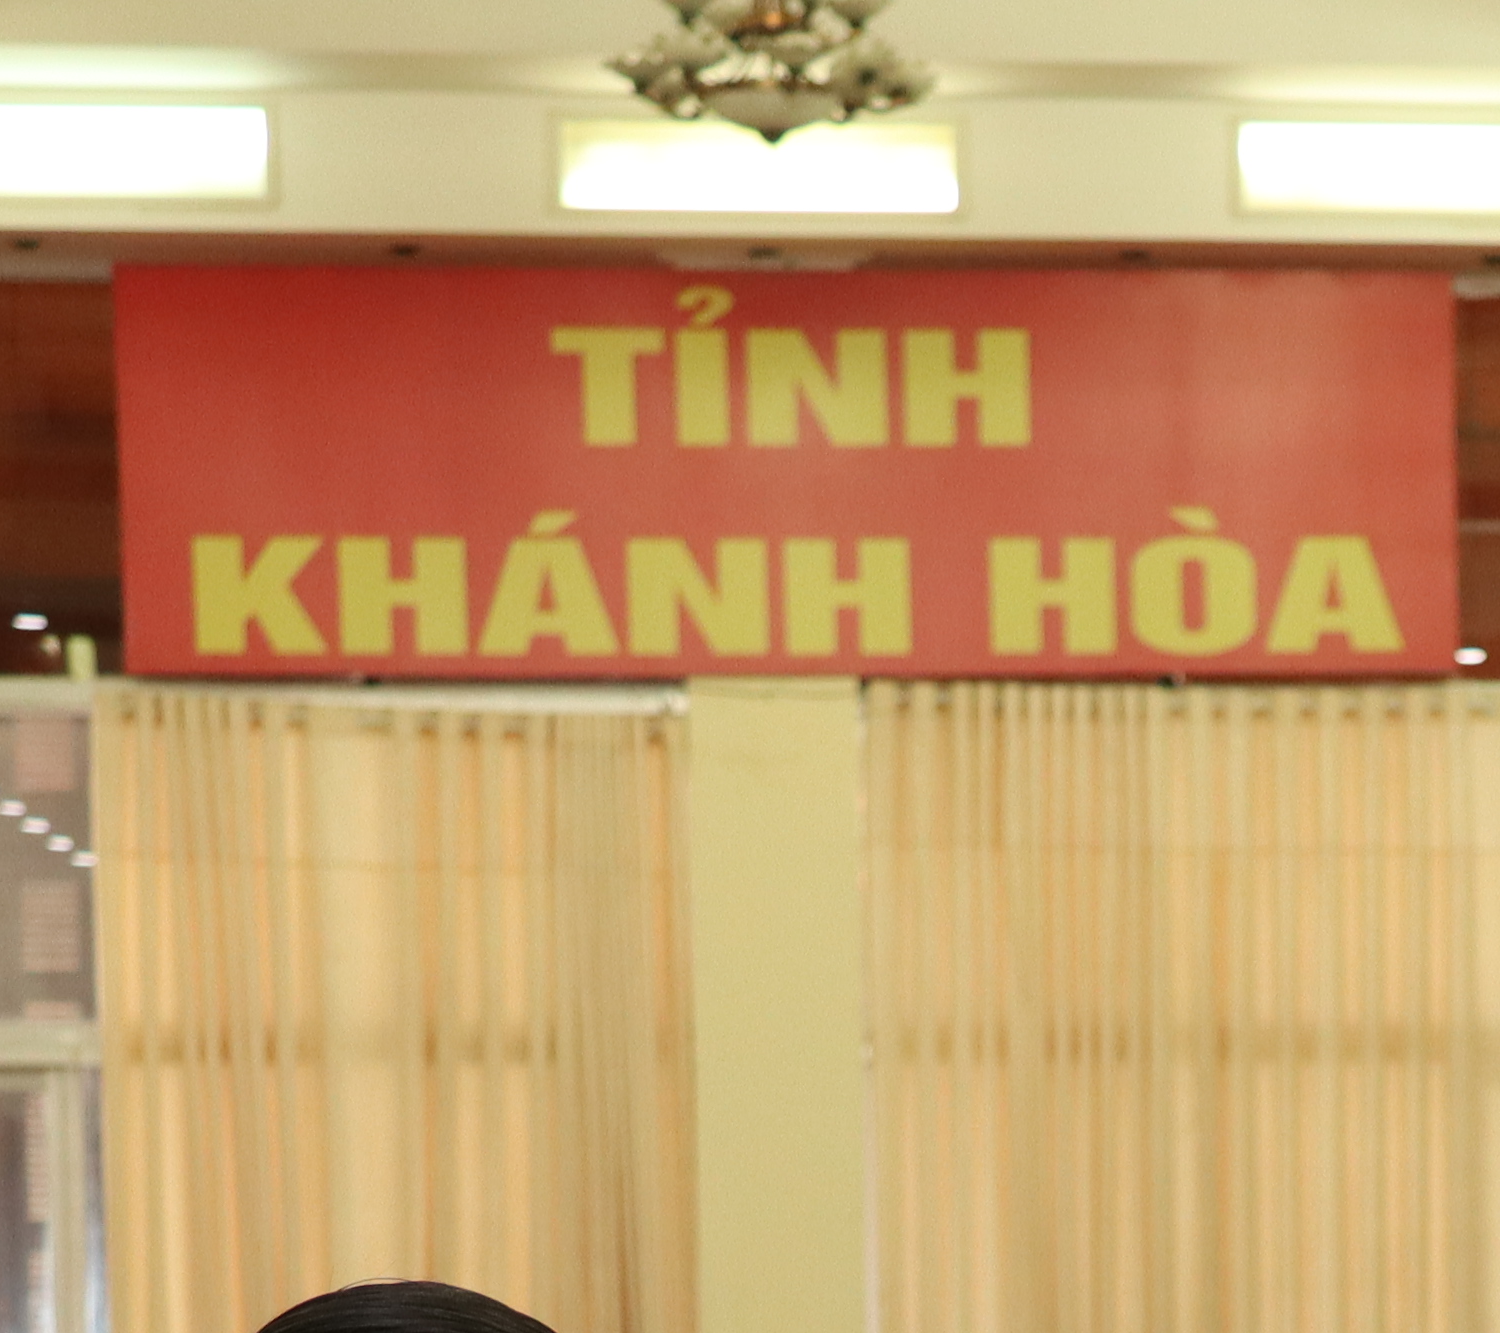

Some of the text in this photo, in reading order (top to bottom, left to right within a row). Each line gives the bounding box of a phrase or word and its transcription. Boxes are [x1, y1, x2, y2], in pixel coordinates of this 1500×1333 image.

[550, 284, 1032, 450] TỈNH
[190, 506, 1405, 656] KHÁNH HÒA
